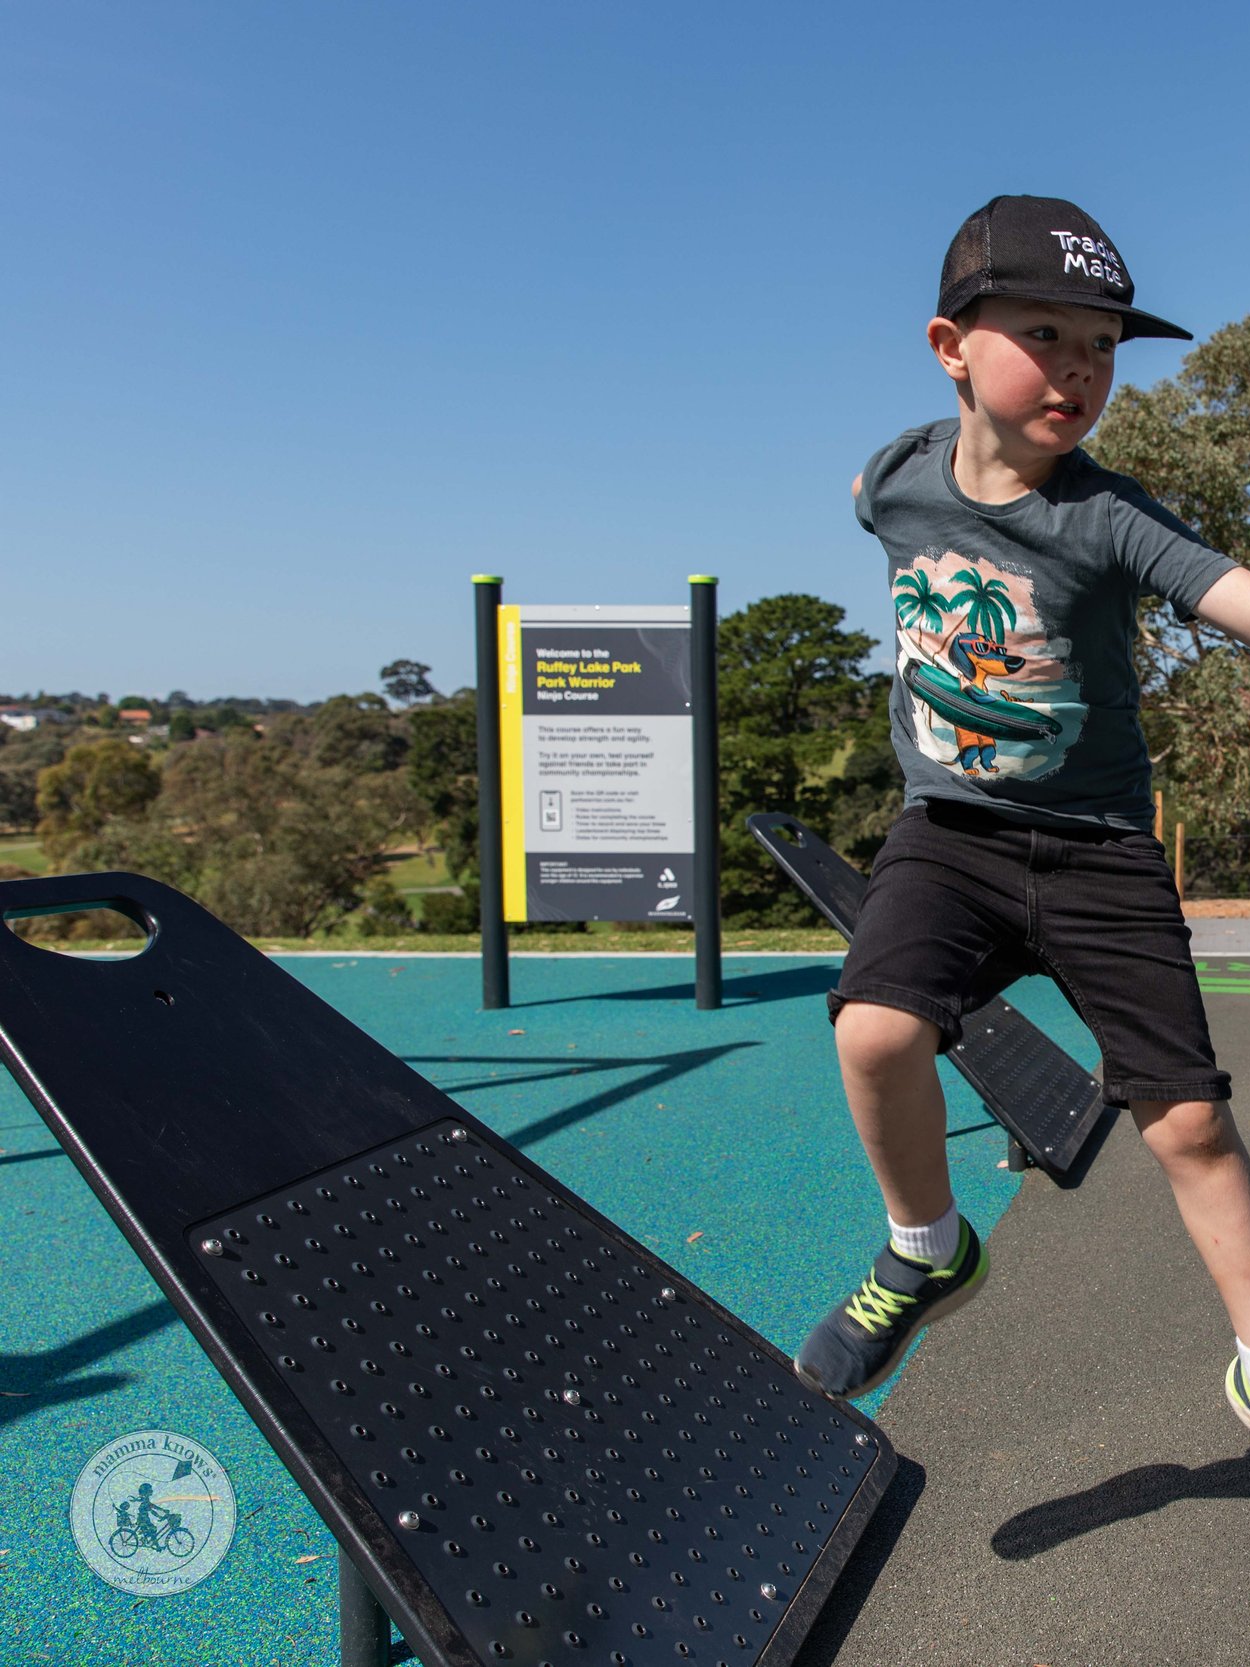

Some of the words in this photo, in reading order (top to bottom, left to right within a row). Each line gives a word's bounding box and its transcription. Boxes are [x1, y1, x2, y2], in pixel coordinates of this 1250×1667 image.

[1050, 230, 1121, 269] Tradie
[1064, 252, 1124, 288] Mate
[536, 648, 580, 658] Welcome
[581, 649, 592, 658] to
[593, 649, 610, 658] the
[537, 661, 577, 675] Ruffey
[579, 662, 610, 673] Lake
[612, 661, 641, 673] Park
[537, 676, 566, 688] Park
[568, 676, 616, 688] Warrior
[537, 691, 563, 702] Ninja
[564, 691, 599, 700] Course
[548, 735, 576, 744] develop
[578, 735, 609, 744] strength
[539, 752, 550, 760] Try
[539, 769, 580, 777] community
